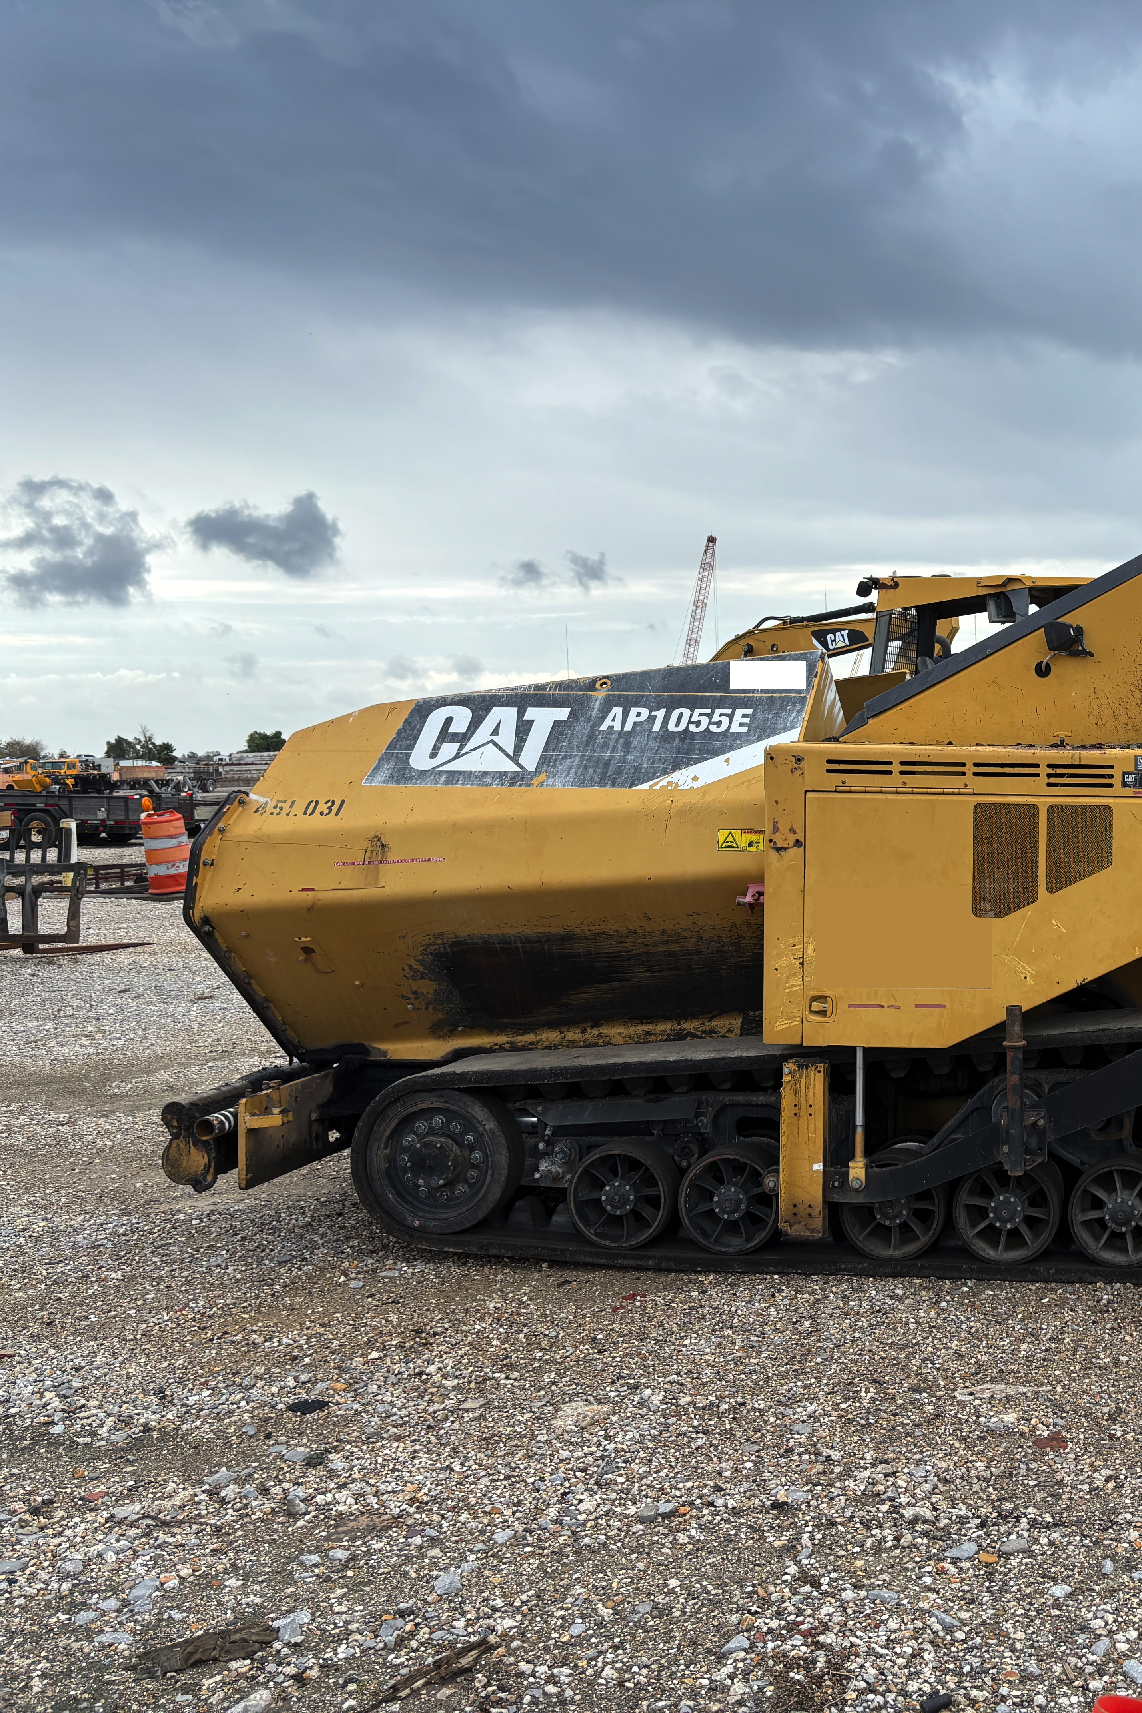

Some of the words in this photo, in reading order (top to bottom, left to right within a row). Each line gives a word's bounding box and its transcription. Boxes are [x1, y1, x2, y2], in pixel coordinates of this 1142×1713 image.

[826, 630, 850, 650] CAT
[599, 706, 753, 734] AP1055E
[409, 705, 572, 772] CAT
